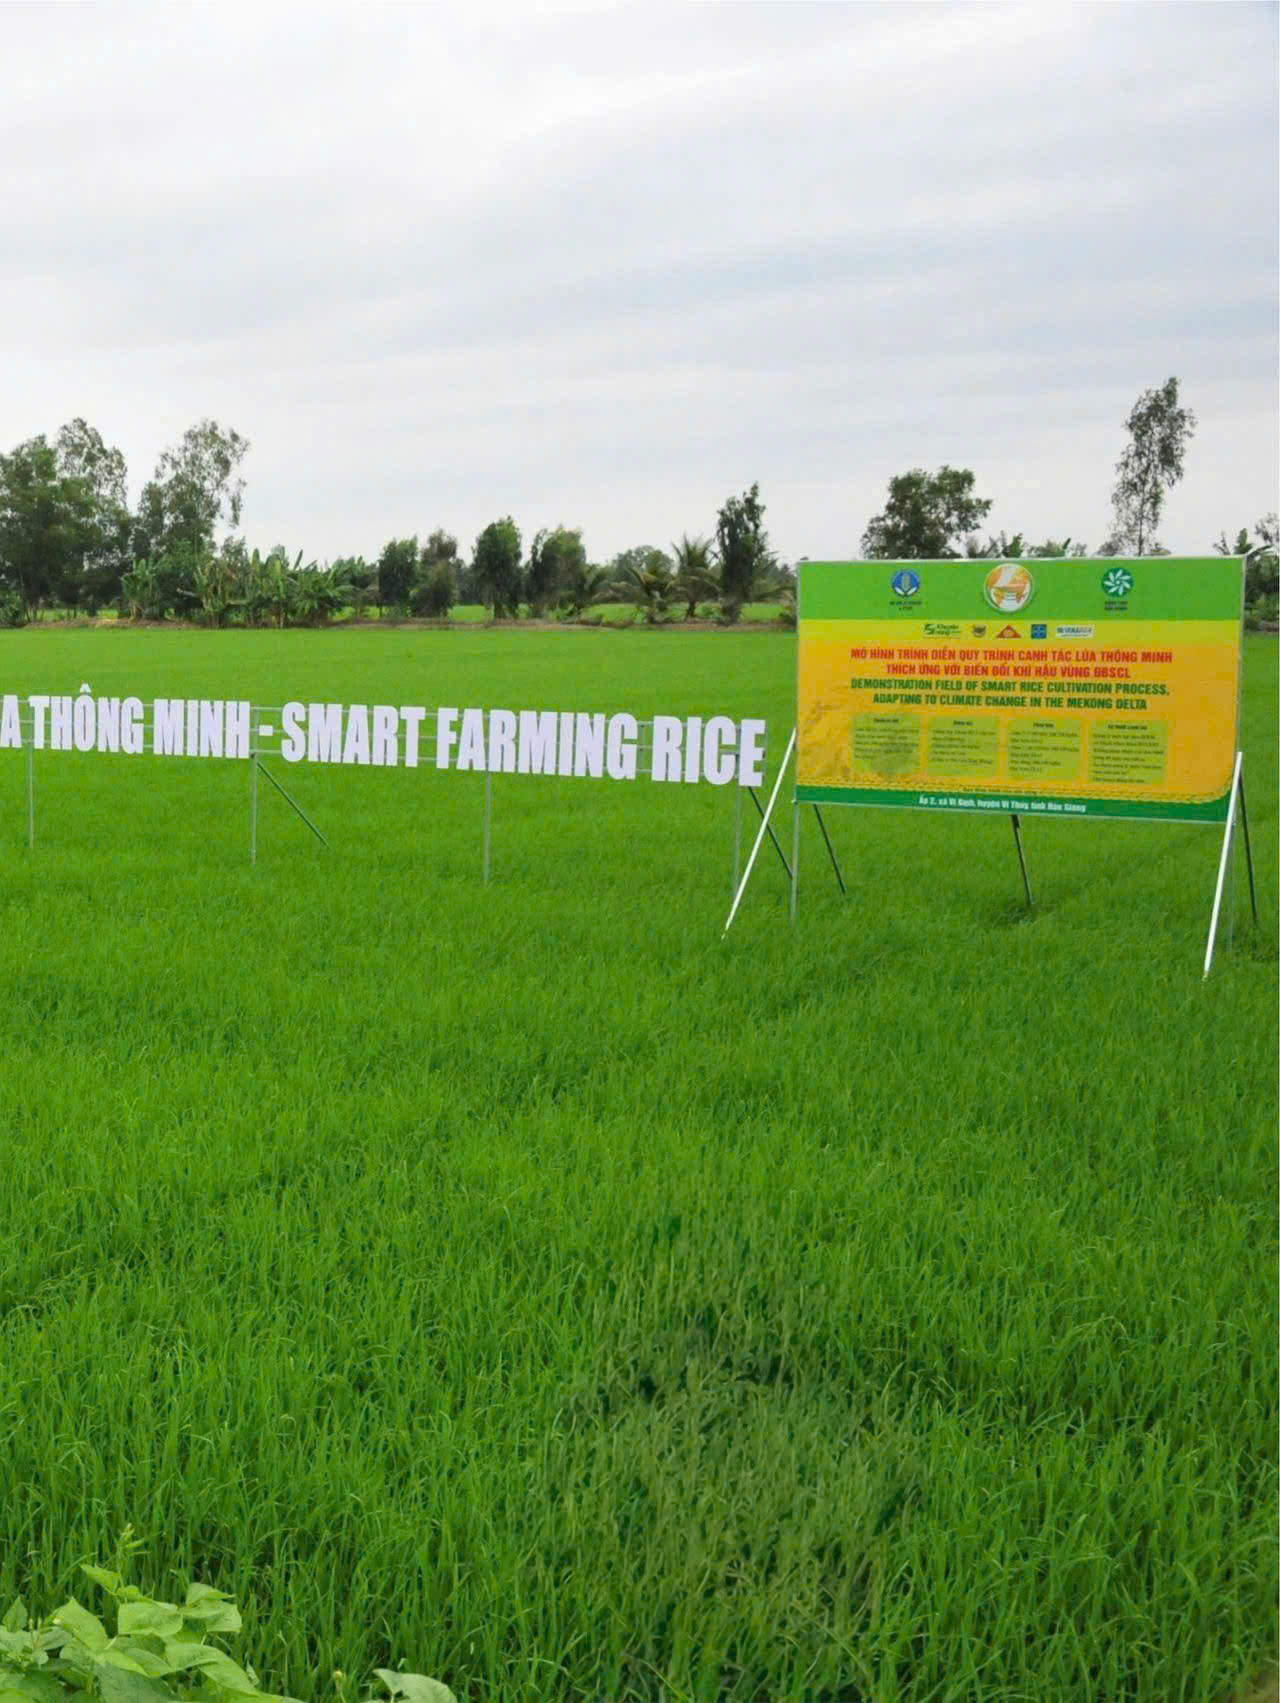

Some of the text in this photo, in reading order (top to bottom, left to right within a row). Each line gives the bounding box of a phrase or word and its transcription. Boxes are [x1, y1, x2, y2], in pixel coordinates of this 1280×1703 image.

[851, 646, 867, 659] MÔ
[870, 646, 894, 660] HÌNH
[898, 647, 928, 660] TRÌNH
[960, 649, 979, 662] QUY
[984, 648, 1015, 662] TRÌNH
[1018, 650, 1048, 662] CANH
[1052, 648, 1072, 662] TÁC
[1076, 649, 1096, 662] LÚA
[1101, 649, 1138, 663] THÔNG
[1141, 651, 1173, 663] MINH
[887, 663, 915, 675] THÍCH
[851, 678, 932, 690] DEMONSTRATION
[936, 680, 962, 691] FIELD
[966, 680, 978, 691] OF
[981, 681, 1016, 691] SMART
[1020, 681, 1043, 692] RICE
[1047, 682, 1112, 693] CULTIVATION
[873, 693, 1147, 709] ADAPTING TO CLIMATE CHANGE IN THE MEKONG DELTA
[29, 683, 144, 754] THÔNG
[153, 699, 250, 759] MINH
[281, 702, 426, 768] SMART
[436, 708, 638, 780] FARMING
[651, 716, 766, 786] RICE
